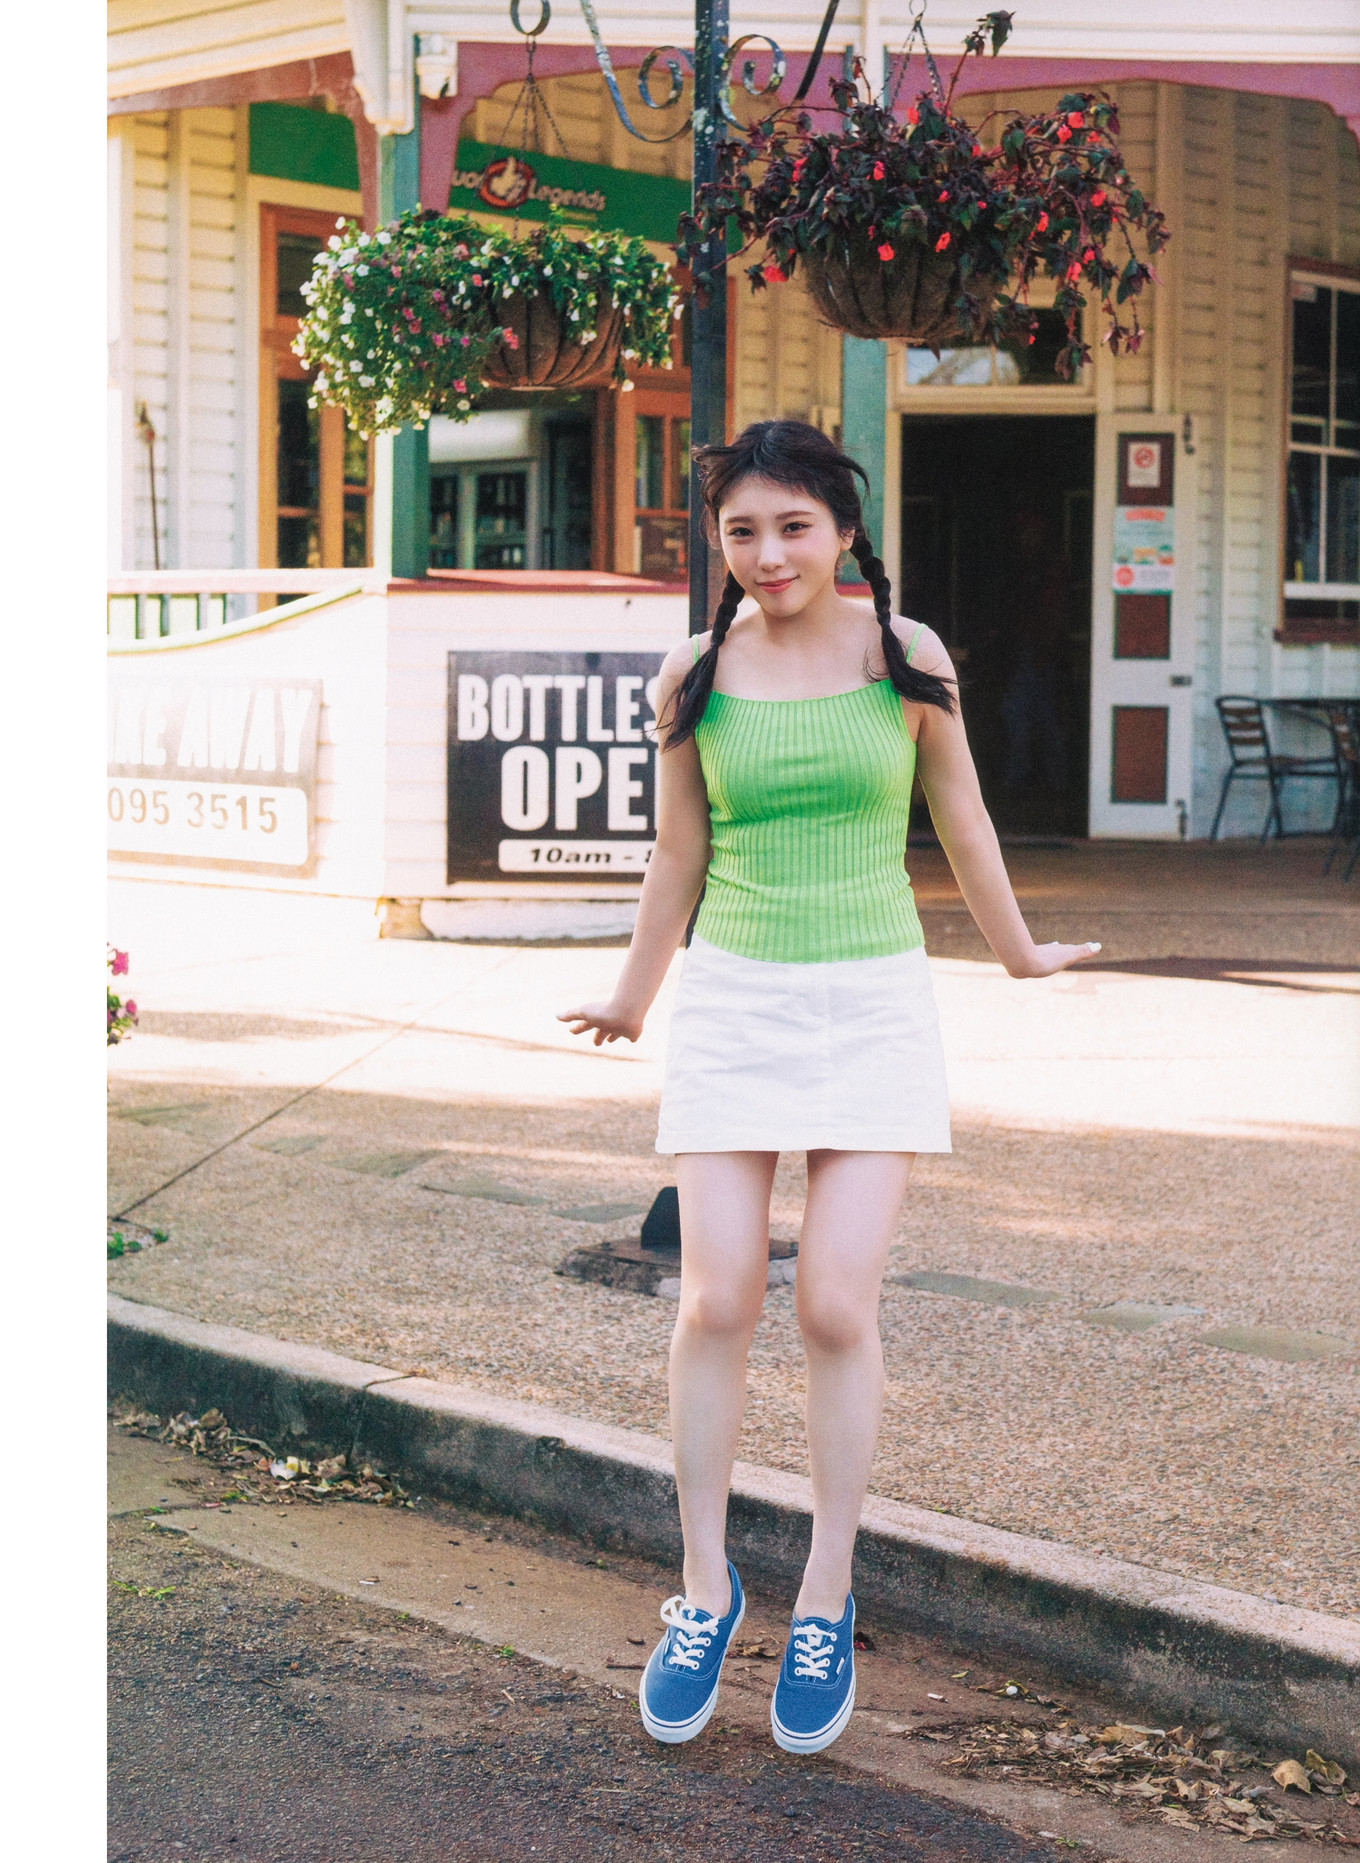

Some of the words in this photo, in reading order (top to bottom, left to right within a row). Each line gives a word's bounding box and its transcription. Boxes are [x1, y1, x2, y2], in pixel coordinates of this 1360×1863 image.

[178, 687, 314, 772] AWAY
[107, 787, 170, 826] 095
[186, 791, 278, 834] 3515
[501, 745, 660, 831] OPE
[531, 848, 611, 863] 10am
